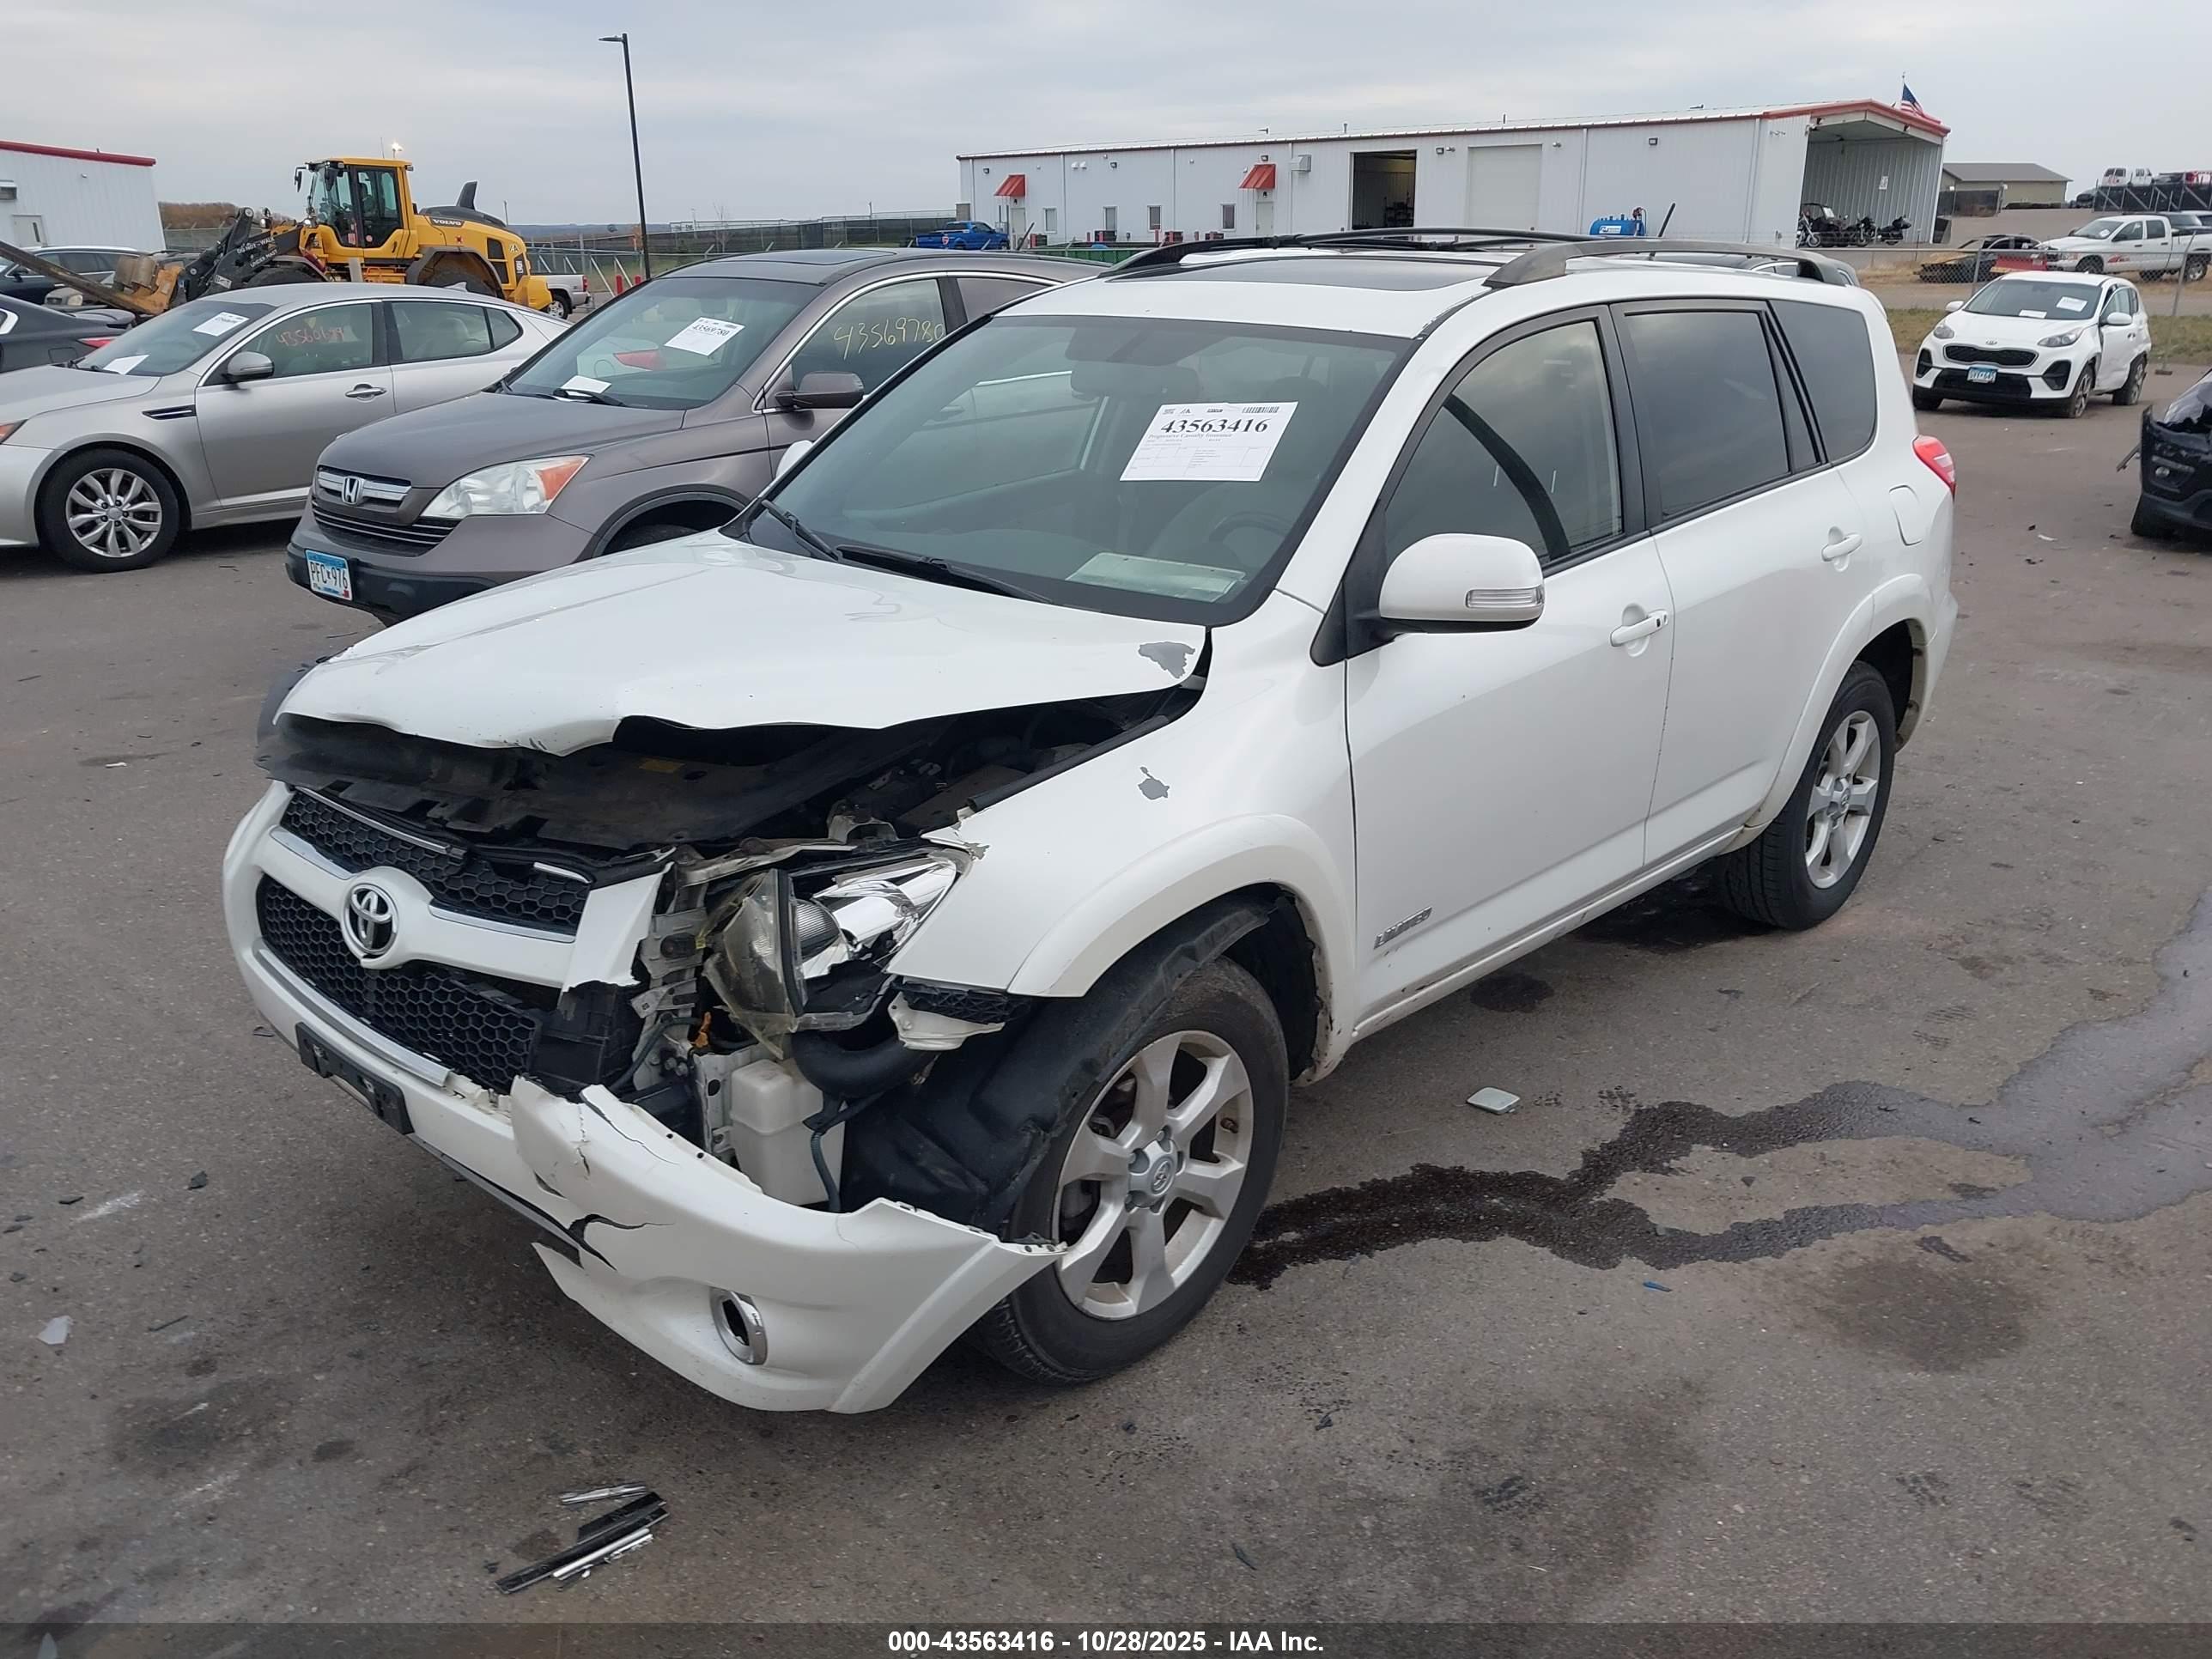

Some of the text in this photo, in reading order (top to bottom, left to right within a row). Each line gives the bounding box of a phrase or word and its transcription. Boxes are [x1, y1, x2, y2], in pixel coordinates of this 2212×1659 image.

[260, 236, 275, 246] WALK
[250, 249, 278, 268] UNDER MAST
[833, 317, 945, 360] 43569780
[1160, 418, 1273, 433] 43563416
